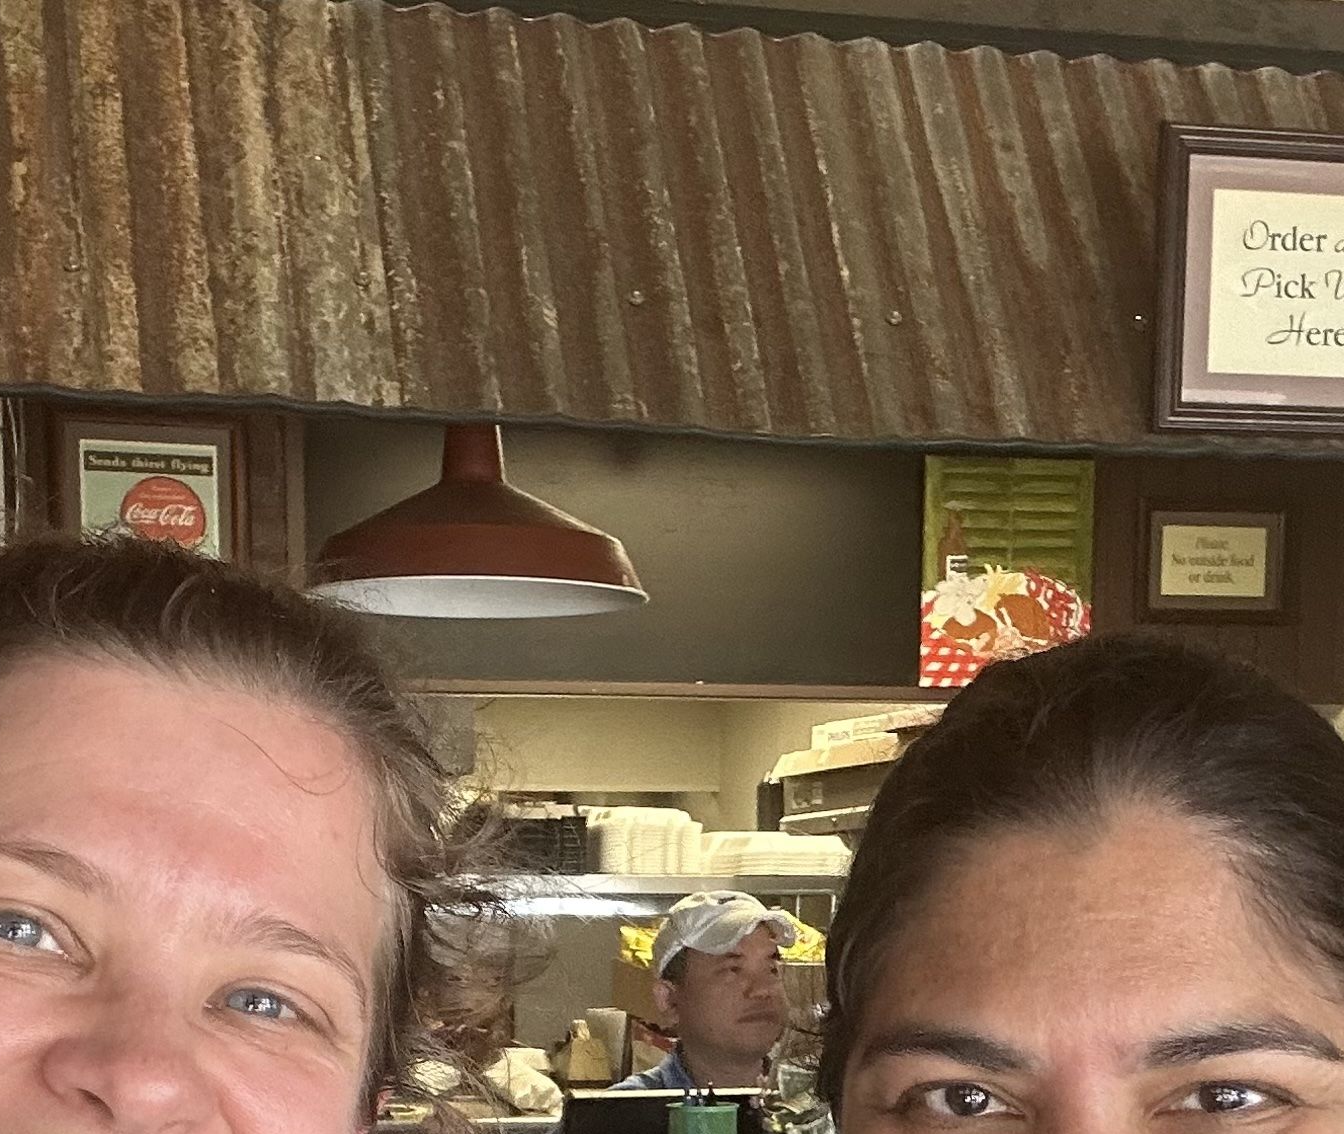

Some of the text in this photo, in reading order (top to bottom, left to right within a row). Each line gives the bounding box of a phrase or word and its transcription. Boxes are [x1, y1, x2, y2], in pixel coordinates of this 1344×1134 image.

[1242, 219, 1327, 251] Order
[1240, 267, 1317, 299] Pick
[88, 455, 209, 475] Sends thirst flying
[125, 503, 198, 527] Coca-Cola
[1229, 553, 1255, 567] food
